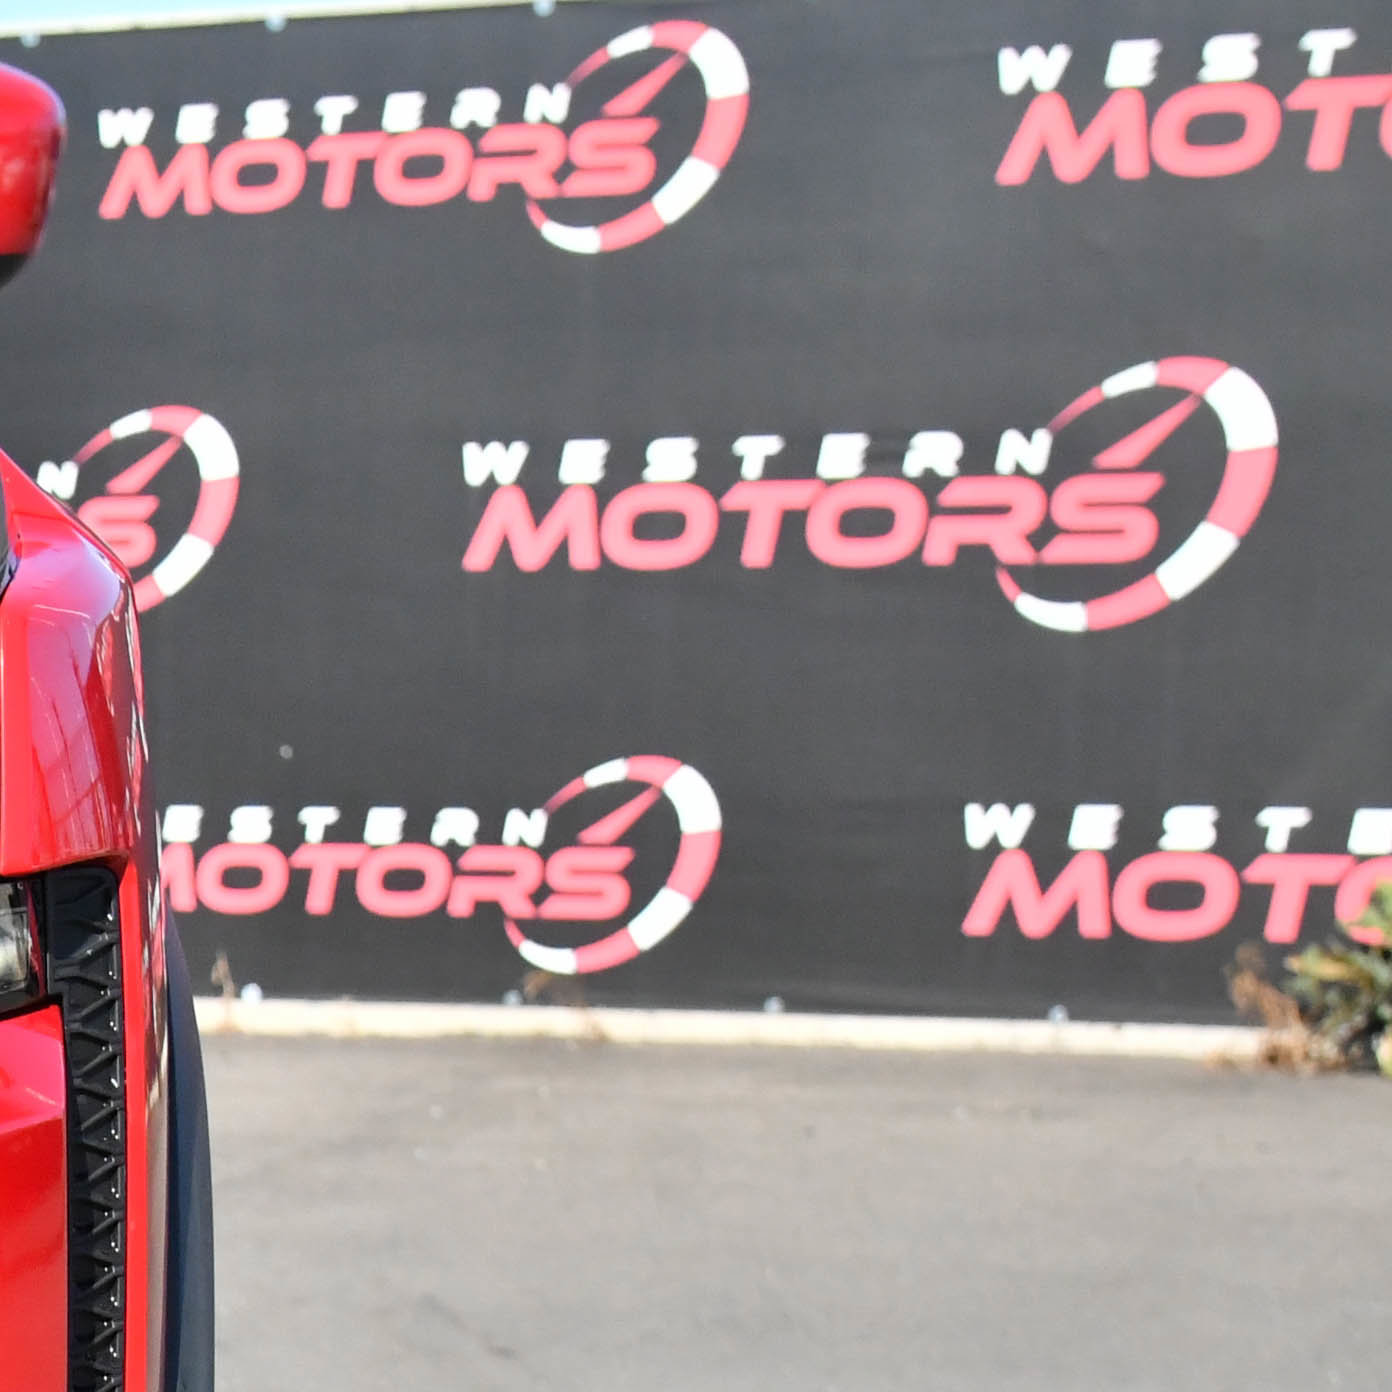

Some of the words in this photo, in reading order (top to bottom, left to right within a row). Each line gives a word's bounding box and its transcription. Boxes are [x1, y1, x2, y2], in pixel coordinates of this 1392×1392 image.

[998, 28, 1357, 95] WEST
[98, 83, 571, 148] WESTERN
[996, 74, 1392, 187] MOT
[98, 117, 660, 219] MOTORS
[462, 428, 1054, 486] WESTERN
[462, 472, 1165, 573] MOTORS
